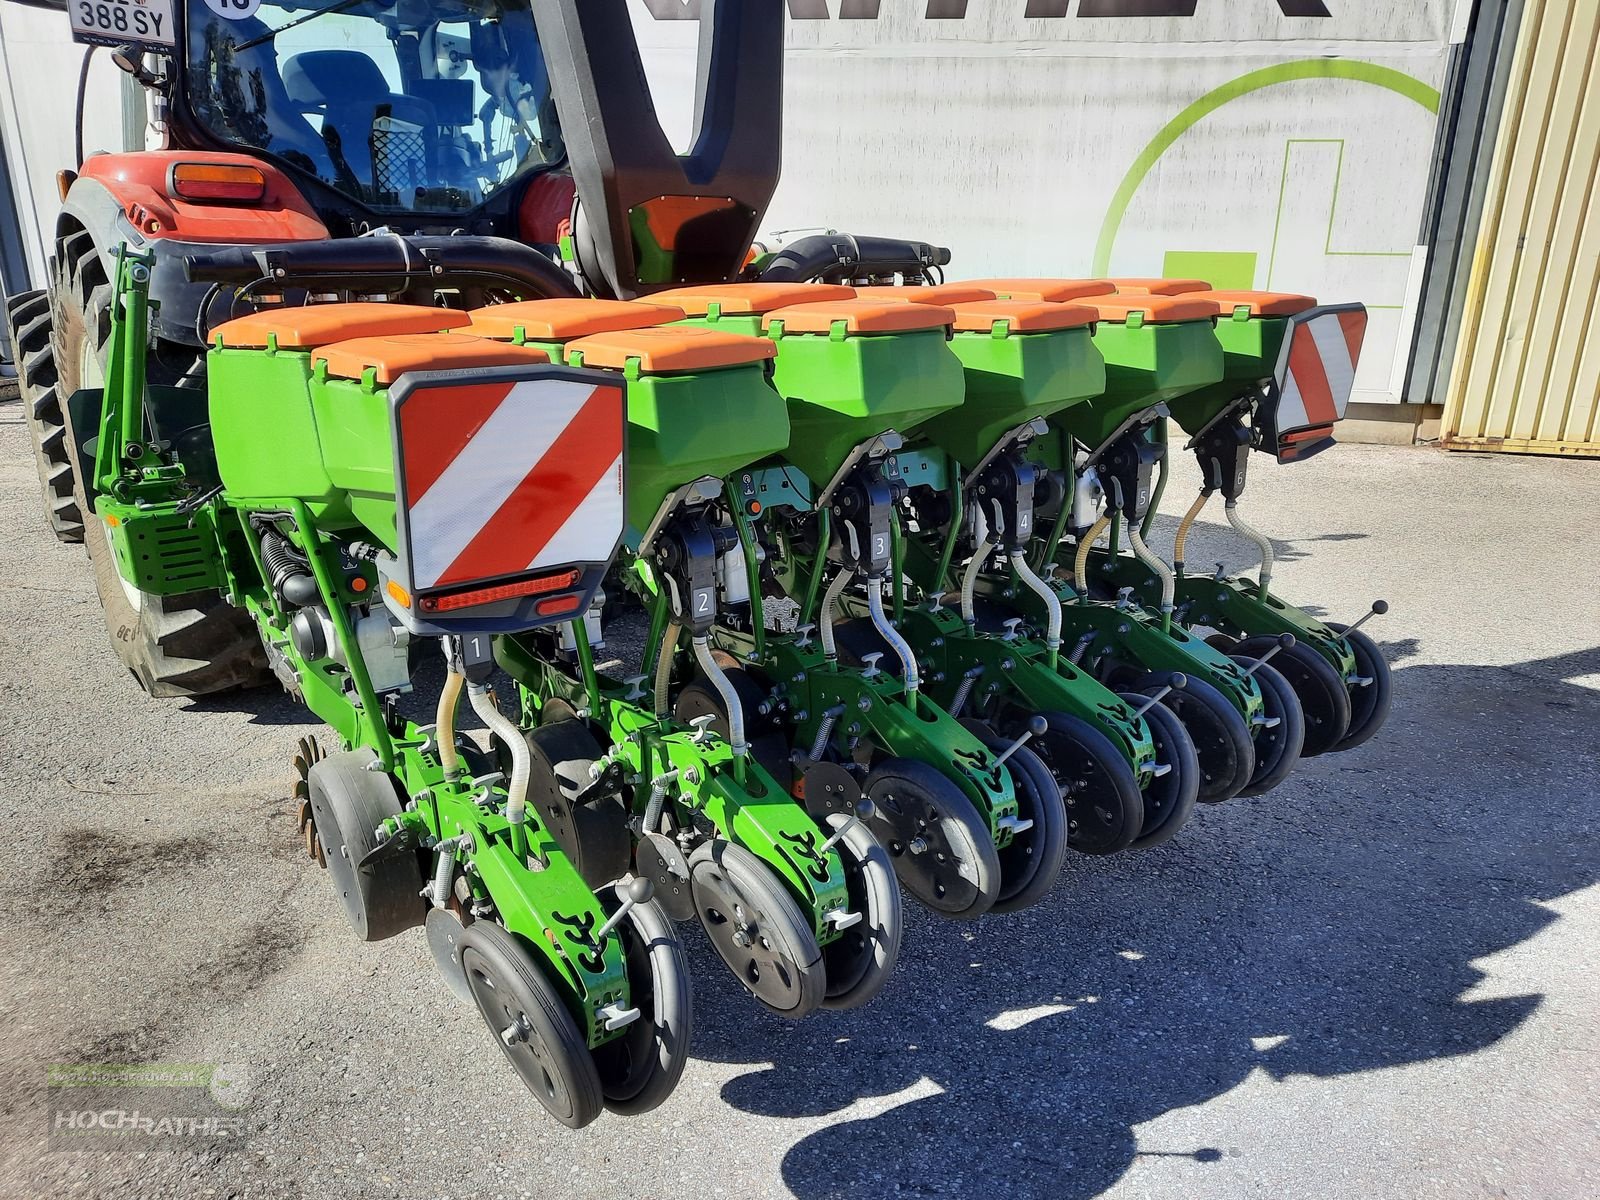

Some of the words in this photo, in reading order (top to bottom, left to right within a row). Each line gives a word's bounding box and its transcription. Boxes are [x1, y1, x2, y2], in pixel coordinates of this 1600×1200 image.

[79, 1, 128, 31] 388
[133, 9, 163, 37] SY
[1237, 471, 1244, 485] 6
[1139, 490, 1147, 505] 5
[1020, 514, 1028, 529] 4
[876, 537, 884, 555] 3
[698, 593, 708, 612] 2
[471, 637, 481, 658] 1
